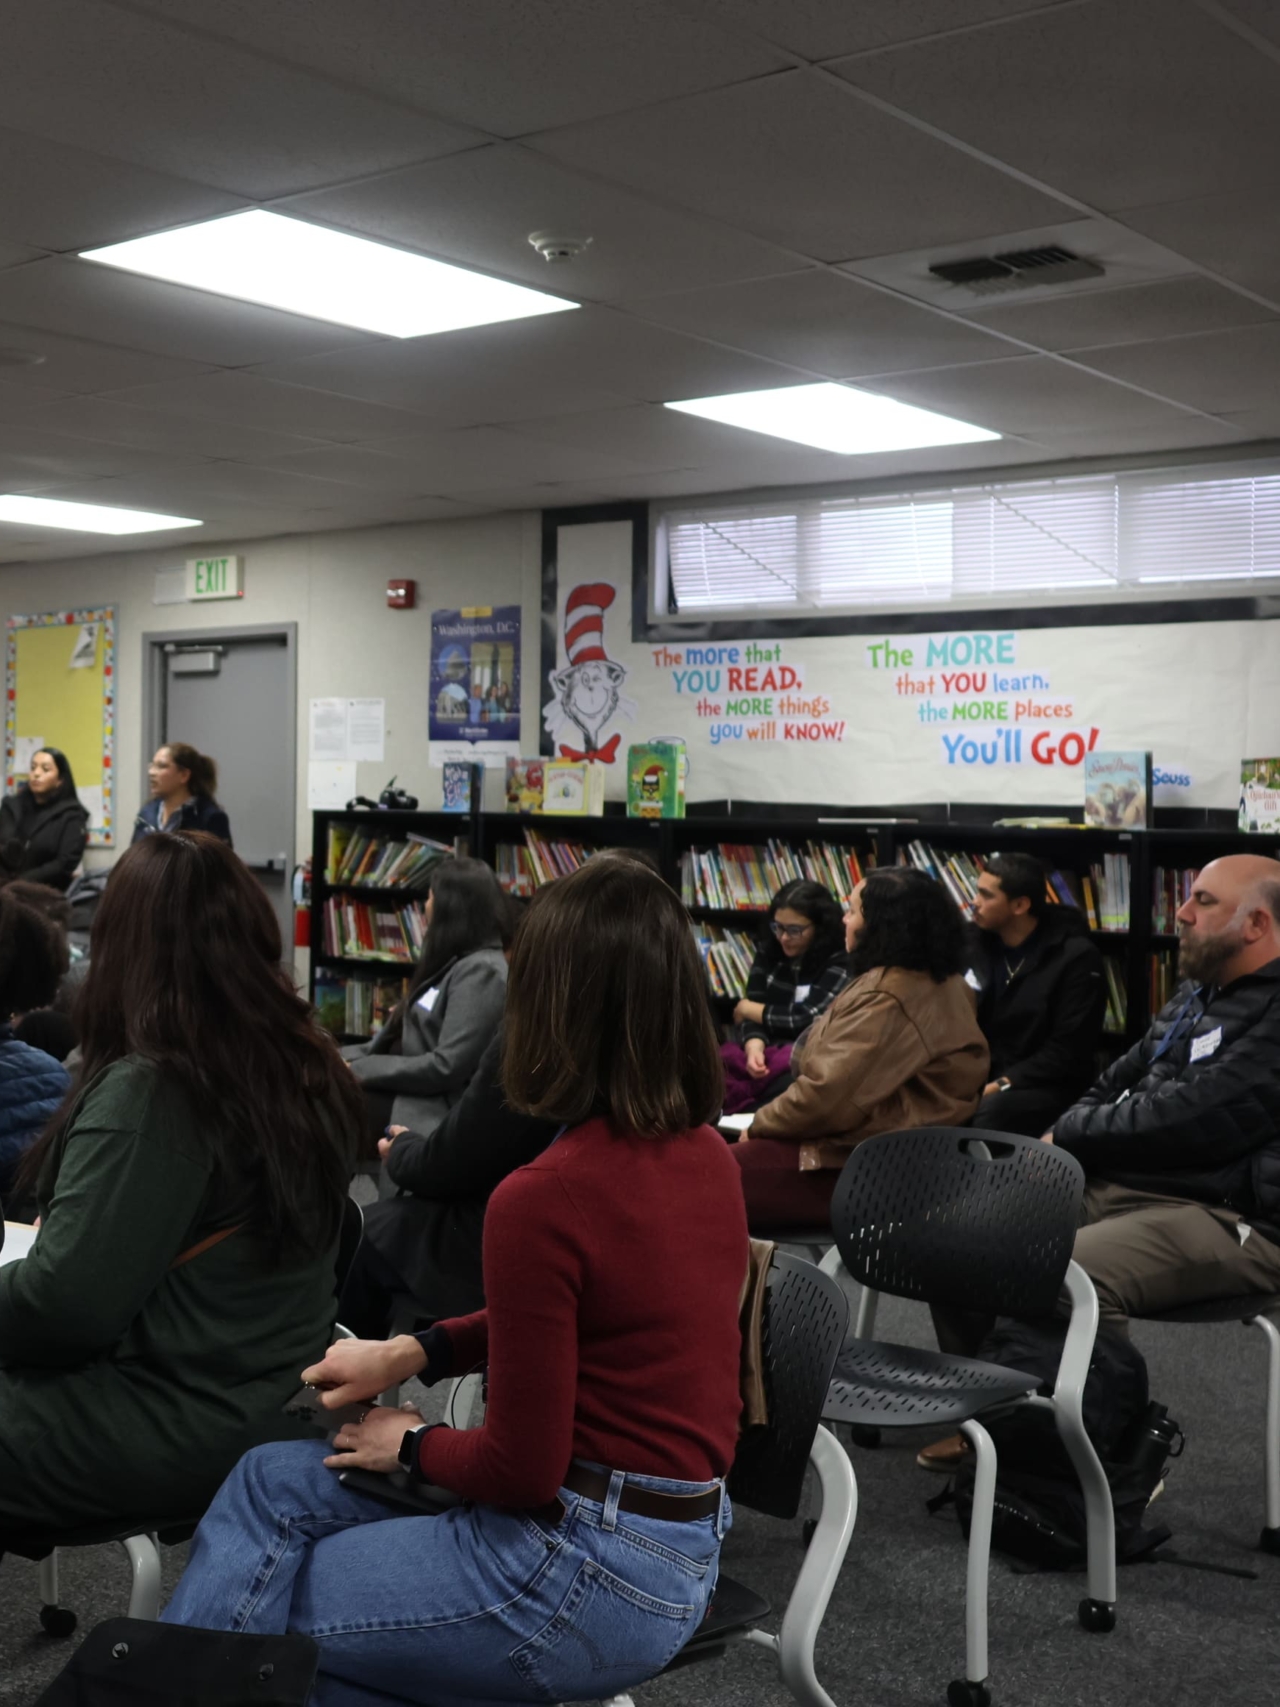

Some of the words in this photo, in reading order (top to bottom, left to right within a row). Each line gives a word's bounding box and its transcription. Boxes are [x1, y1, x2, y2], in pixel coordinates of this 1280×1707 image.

[195, 558, 228, 593] EXIT
[652, 646, 682, 667] The
[686, 647, 740, 665] more
[745, 642, 781, 663] that
[867, 638, 914, 668] The
[926, 633, 1015, 667] MORE
[672, 669, 720, 693] YOU
[727, 665, 802, 692] READ,
[896, 672, 935, 695] that
[941, 672, 987, 694] YOU
[993, 672, 1050, 693] learn,
[696, 697, 721, 717] the
[725, 697, 773, 716] MORE
[778, 694, 830, 718] things
[918, 699, 948, 722] the
[952, 700, 1008, 721] MORE
[1014, 698, 1073, 722] places
[710, 723, 743, 744] you
[747, 720, 776, 740] will
[783, 721, 845, 741] KNOW!
[942, 727, 1021, 765] You'll
[1031, 727, 1100, 766] GO!
[1152, 768, 1191, 787] Seuss
